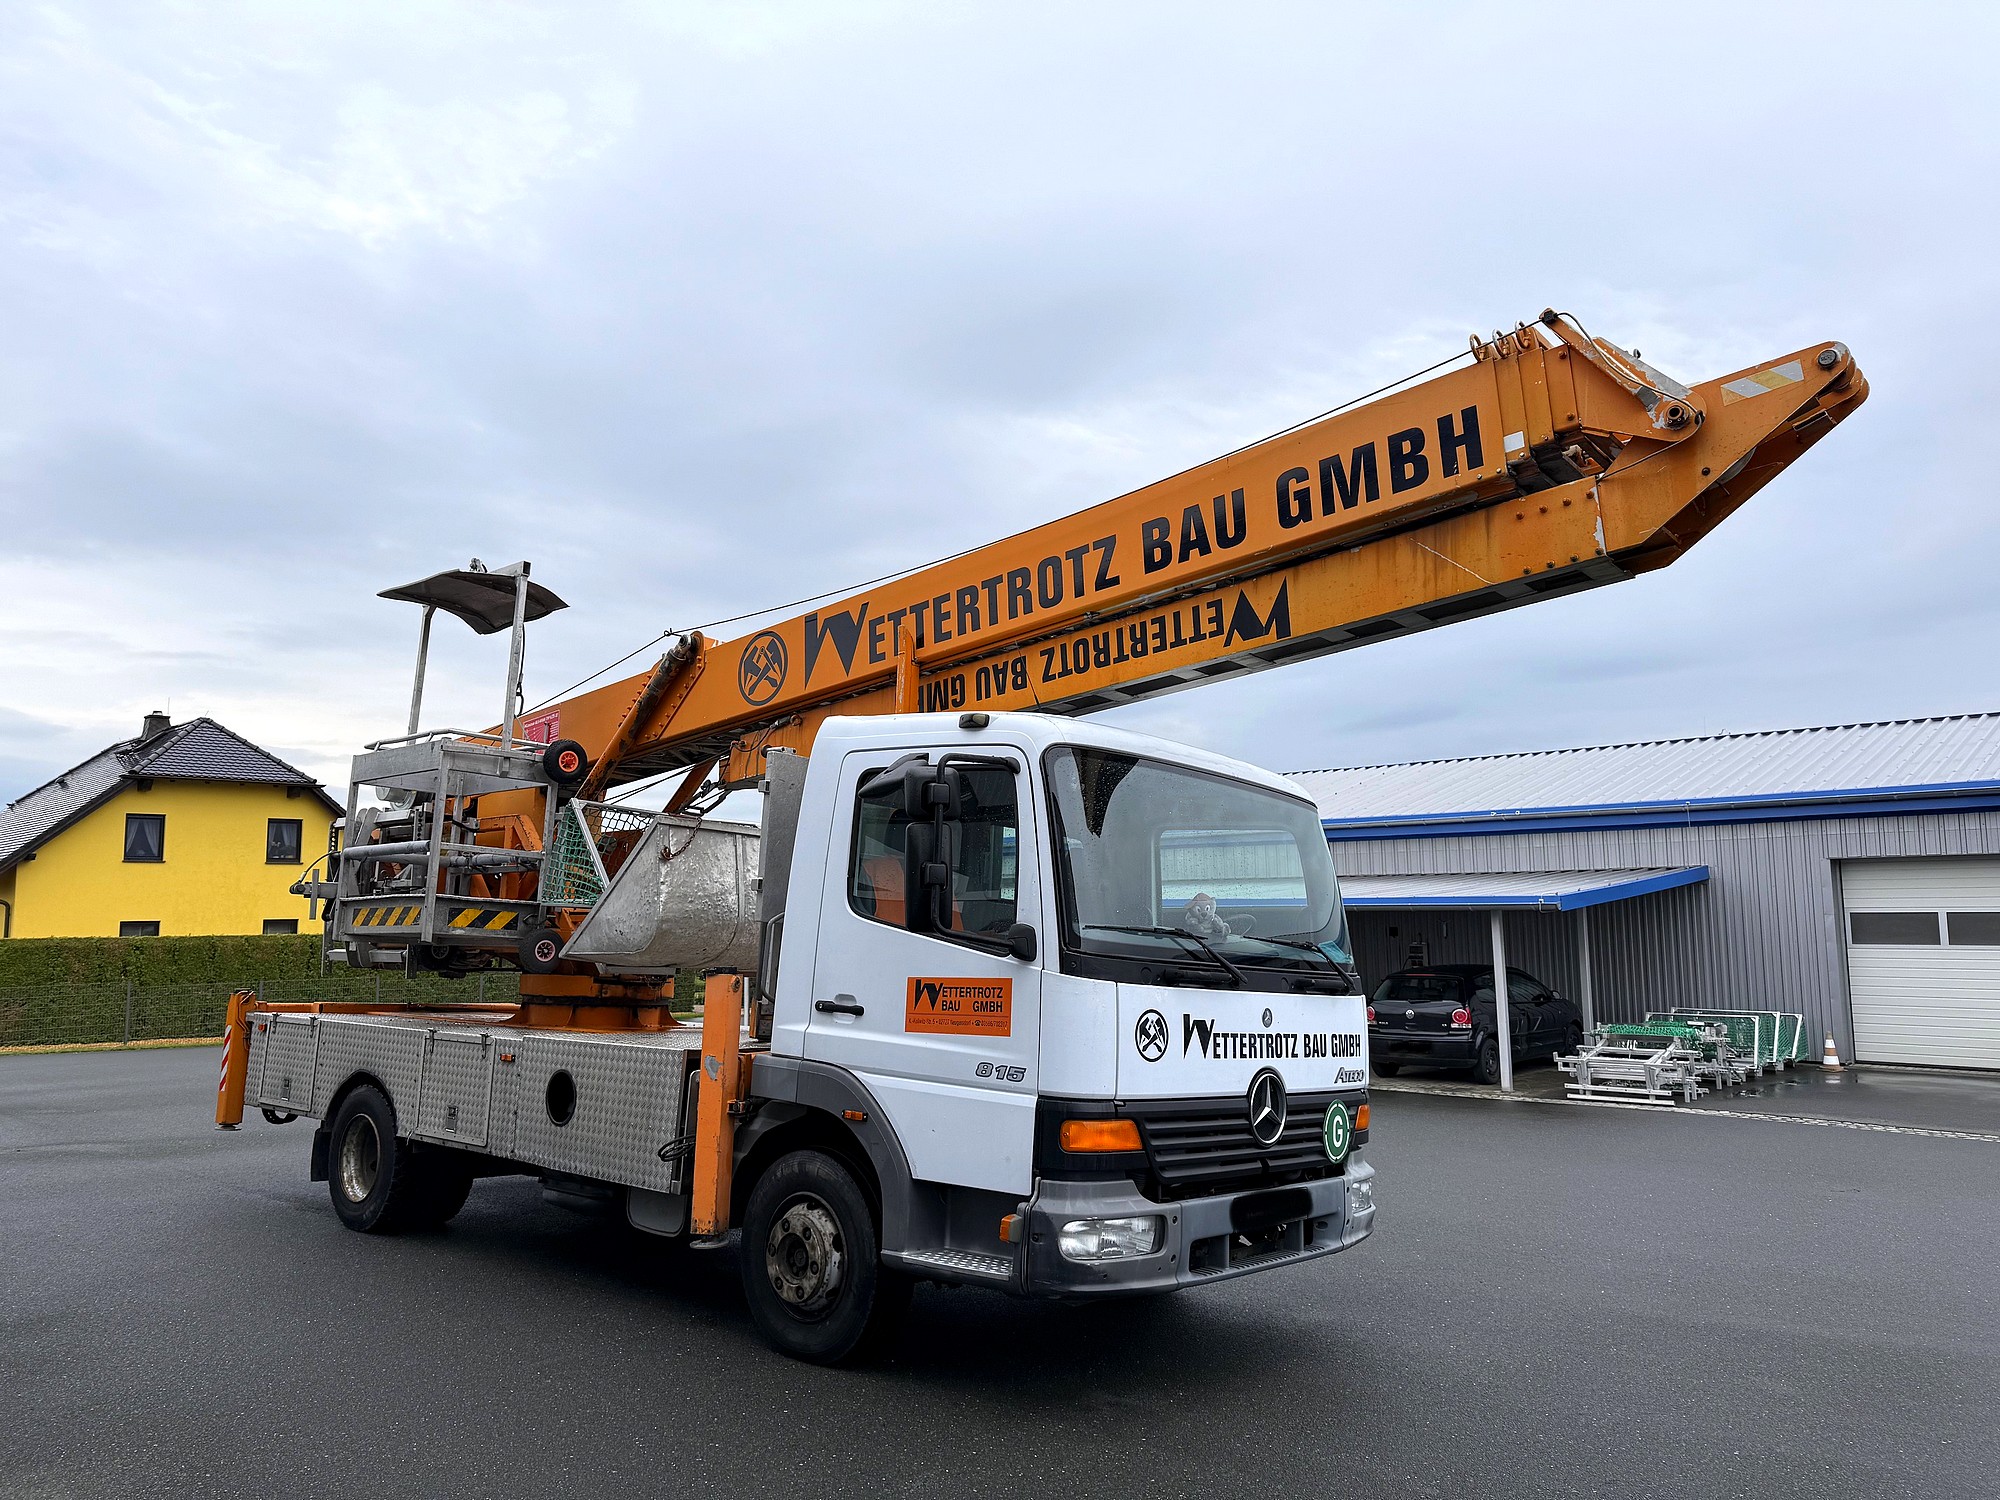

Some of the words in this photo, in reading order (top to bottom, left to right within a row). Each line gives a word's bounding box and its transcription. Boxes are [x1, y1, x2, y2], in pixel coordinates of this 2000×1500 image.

[804, 535, 1121, 690] WETTERTROTZ
[1142, 487, 1248, 575] BAU
[1276, 404, 1485, 529] GMBH
[1042, 577, 1291, 680] WETTERTROTZ
[918, 673, 966, 713] GM
[975, 655, 1027, 701] BAU
[914, 979, 1004, 1011] WETTERTROTZ
[941, 1000, 961, 1012] BAU
[972, 1001, 1003, 1012] GMBH
[1183, 1014, 1298, 1059] WETTERTROTZ
[1303, 1034, 1327, 1058] BAU
[1331, 1033, 1361, 1058] GMBH
[975, 1062, 1027, 1082] 815
[1333, 1115, 1343, 1148] G
